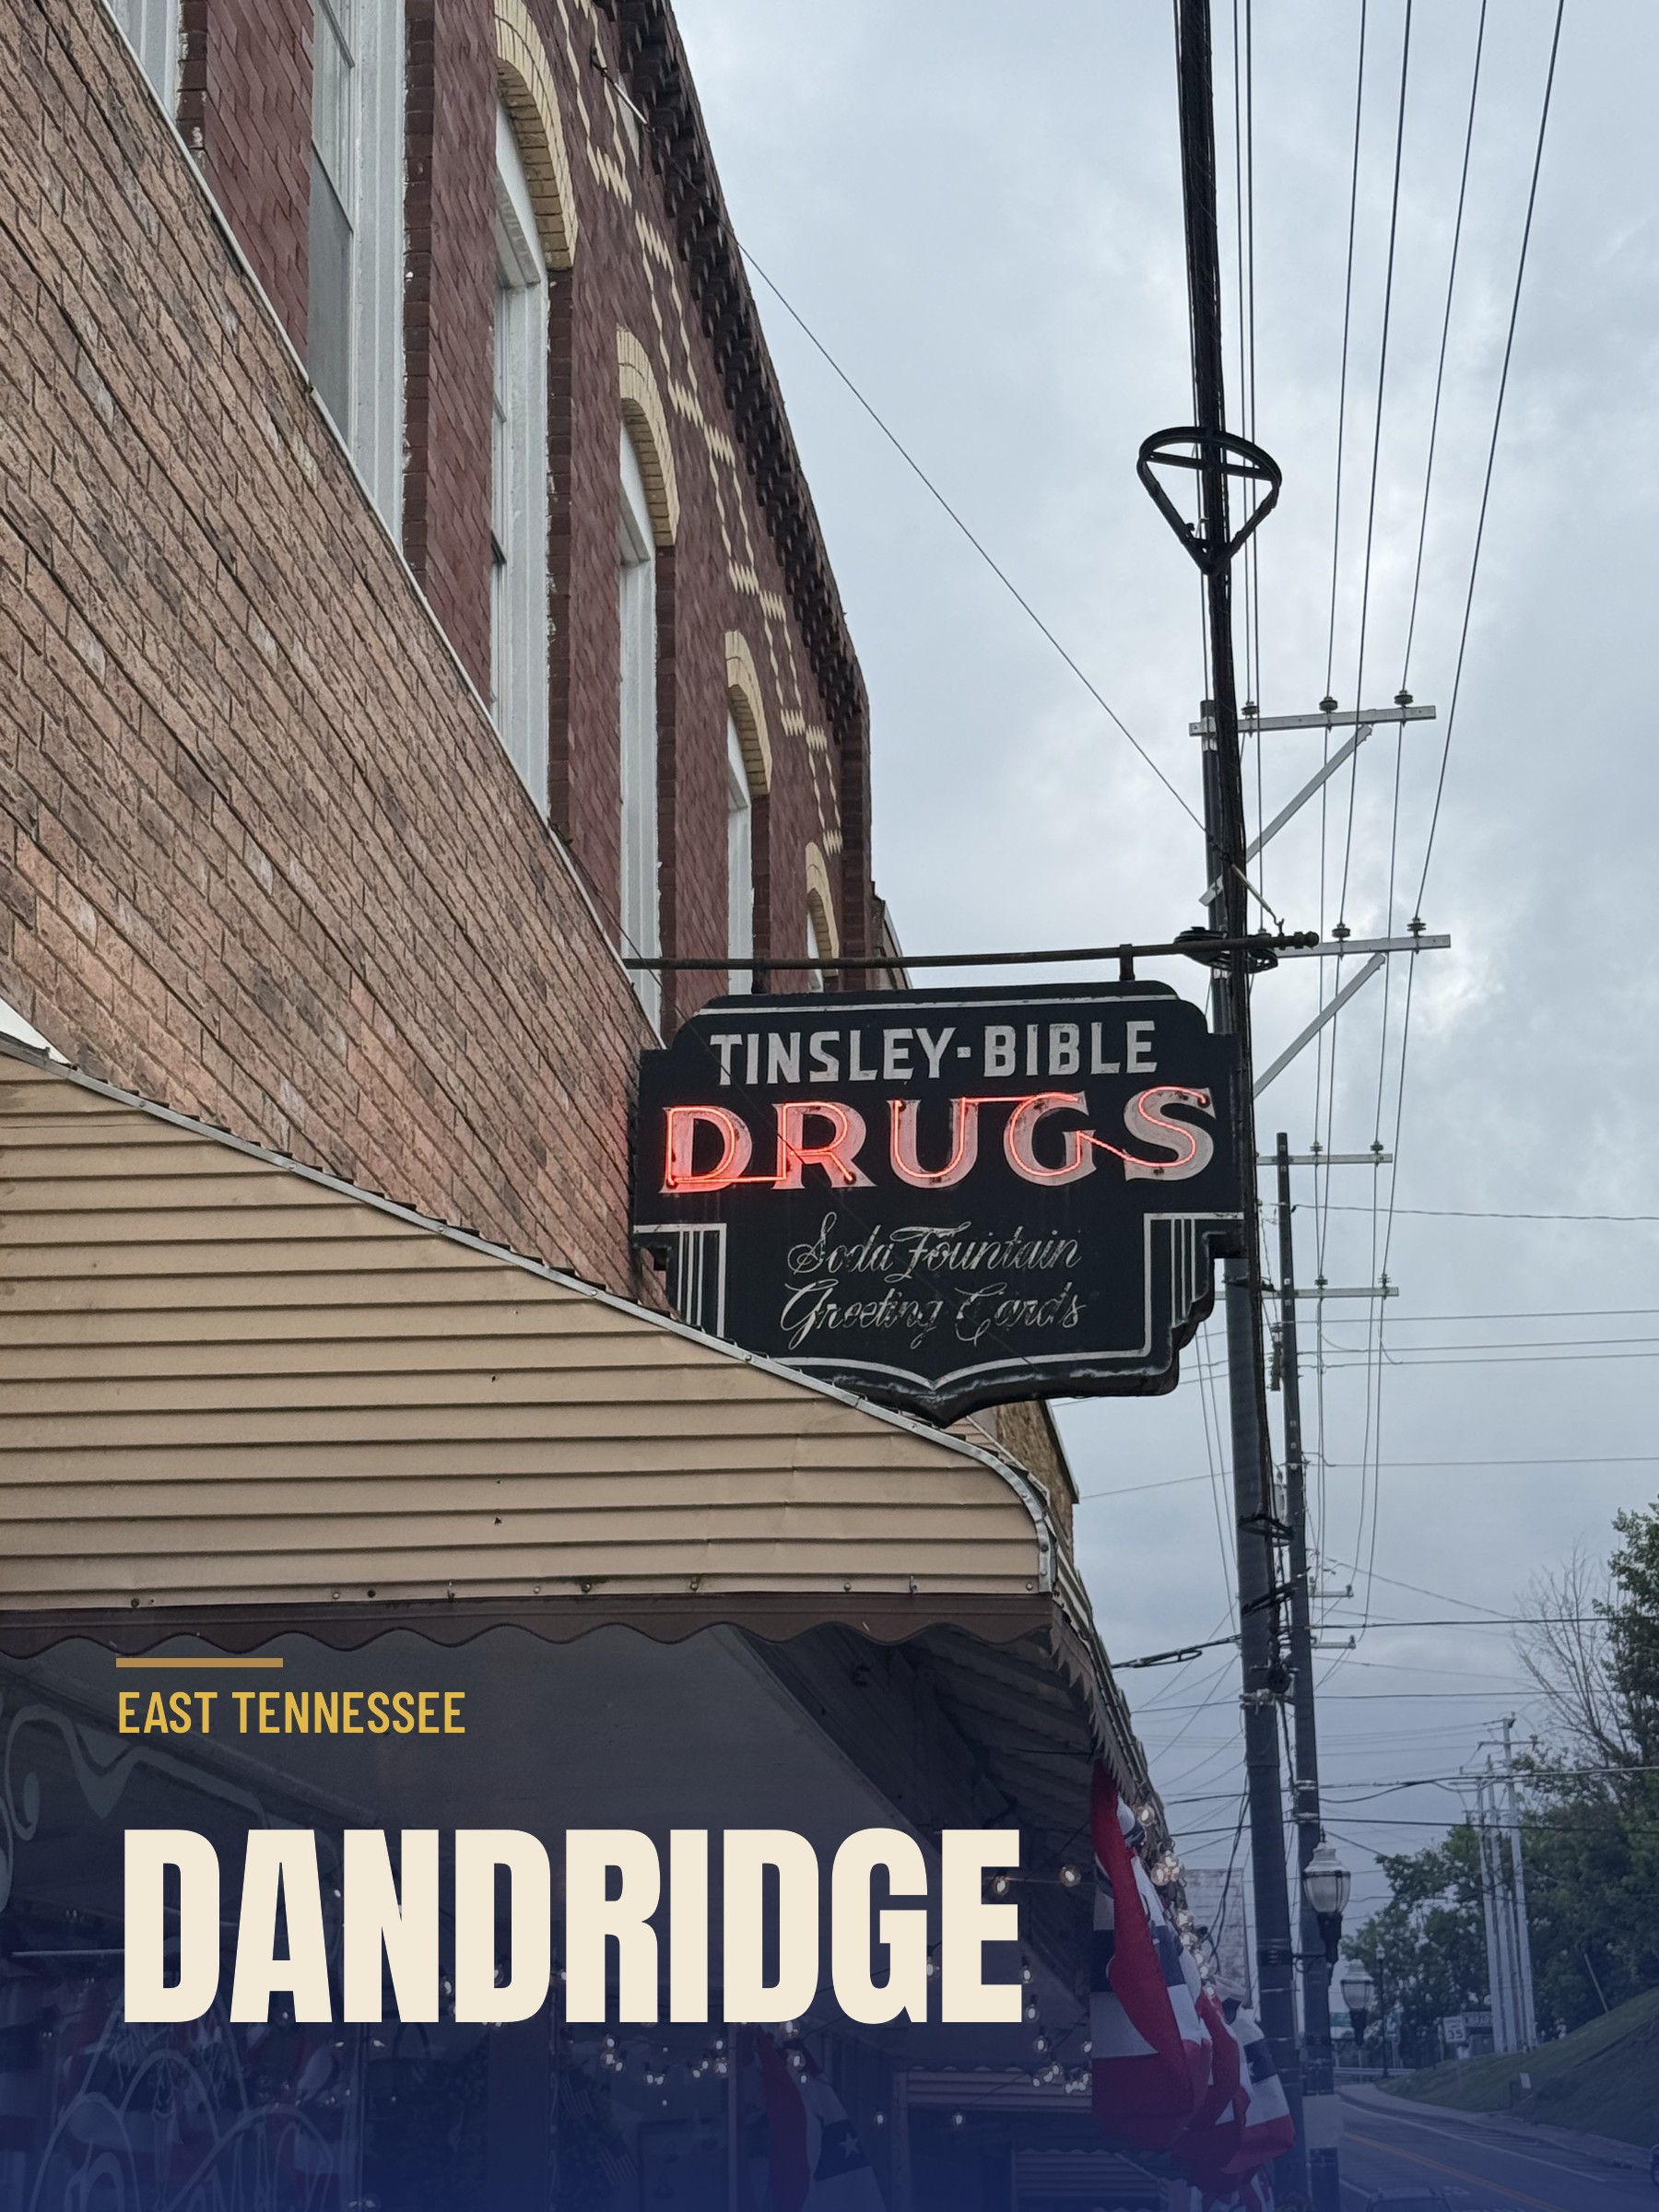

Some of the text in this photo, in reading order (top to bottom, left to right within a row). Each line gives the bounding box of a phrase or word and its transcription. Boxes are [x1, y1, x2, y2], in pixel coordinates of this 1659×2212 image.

[710, 1020, 1158, 1086] TINSLEY-BIBLE
[658, 1085, 1217, 1194] DRUGS
[787, 1211, 1082, 1283] Soda Fountain
[780, 1278, 1088, 1349] Greeting Cards
[1447, 2028, 1464, 2040] 35
